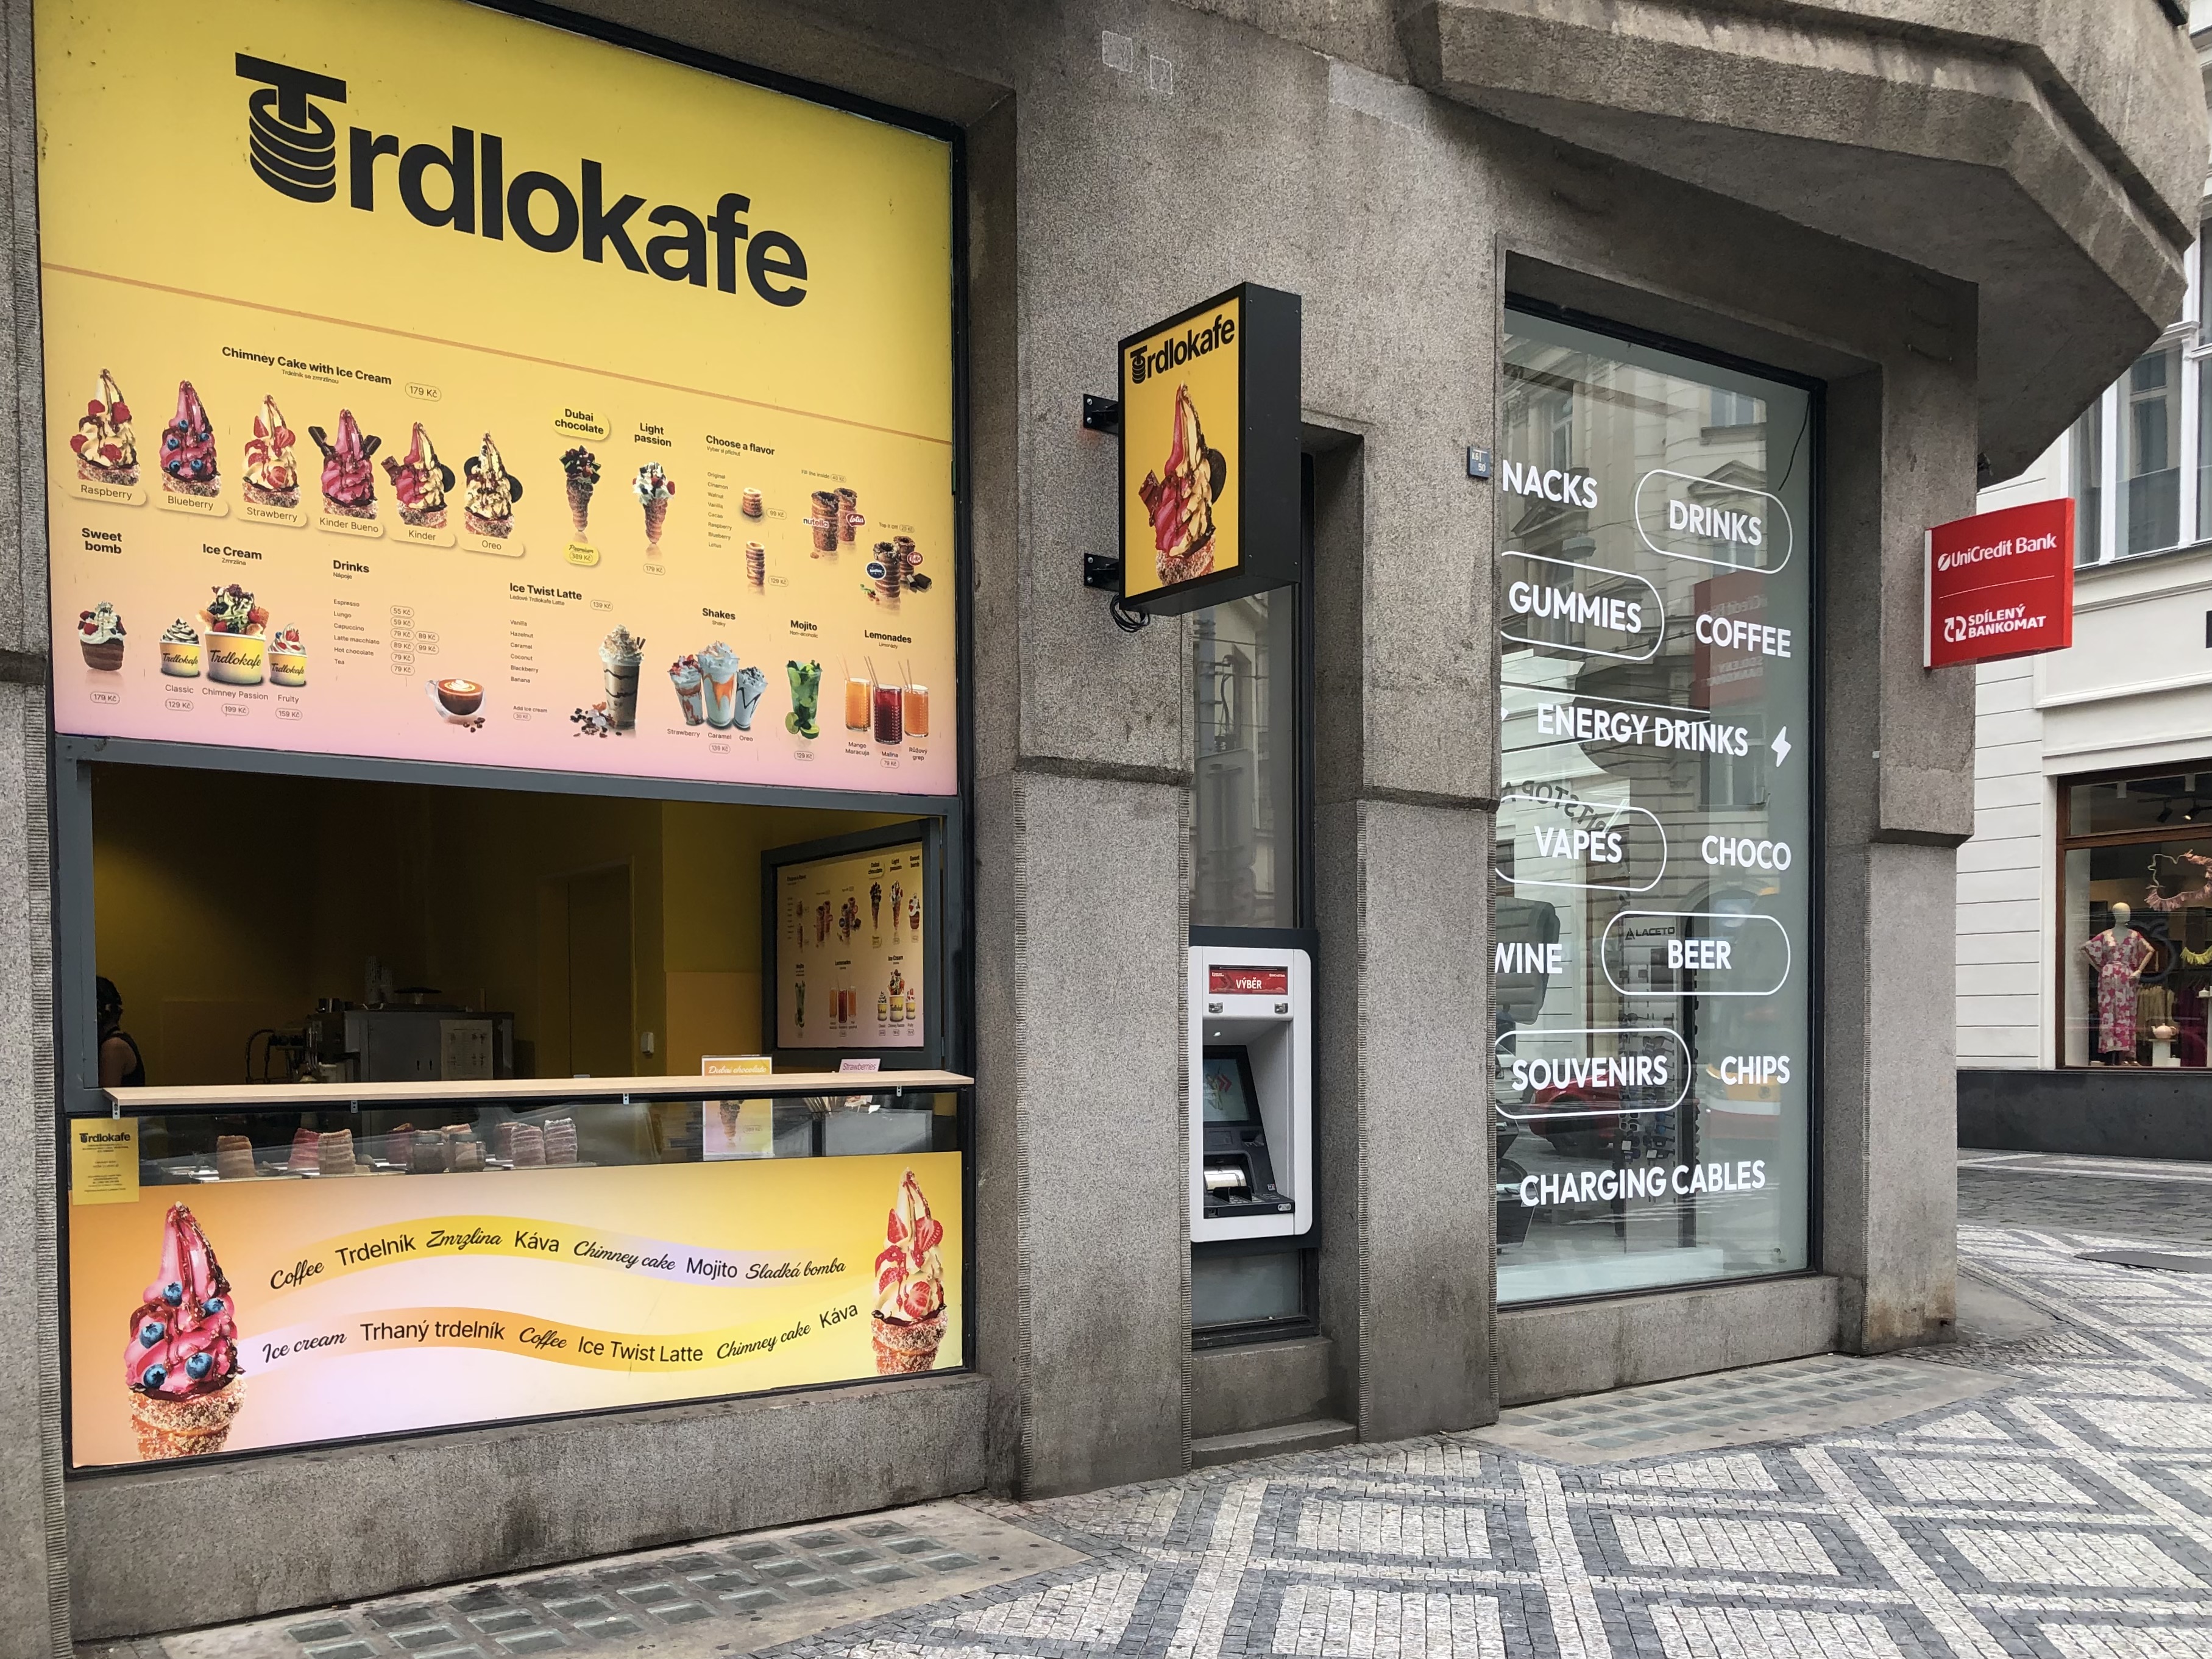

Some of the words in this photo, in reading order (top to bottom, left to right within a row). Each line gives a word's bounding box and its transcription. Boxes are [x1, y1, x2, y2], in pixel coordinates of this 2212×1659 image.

[235, 52, 808, 308] Trdlokafe
[1130, 314, 1235, 385] Trdlokafe
[222, 346, 275, 366] Chimney
[277, 355, 307, 371] Cake
[308, 363, 334, 375] with
[336, 366, 353, 378] Ice
[355, 368, 392, 385] Cream
[409, 385, 424, 396] 179
[426, 387, 438, 399] Kč
[565, 408, 594, 422] Dubai
[555, 419, 604, 435] chocolate
[640, 422, 664, 435] Light
[634, 433, 672, 447] passion
[706, 435, 741, 449] Choose
[750, 442, 775, 455] flavor
[1502, 459, 1598, 509] NACKS
[80, 484, 132, 502] Raspberry
[168, 496, 214, 511] Blueberry
[246, 506, 298, 522] Strawberry
[319, 517, 349, 530] Kinder
[350, 520, 379, 533] Bueno
[708, 522, 732, 531] Raspberry
[803, 519, 829, 528] nutella
[1670, 499, 1762, 546] DRINKS
[82, 527, 122, 542] Sweet
[408, 530, 436, 541] Kinder
[85, 541, 122, 555] bomb
[202, 543, 221, 555] Ice
[222, 546, 262, 560] Cream
[481, 539, 502, 550] Oreo
[1951, 539, 2013, 567] UniCredit
[2016, 532, 2057, 554] Bank
[333, 560, 370, 573] Drinks
[509, 583, 525, 594] Ice
[527, 584, 555, 597] Twist
[556, 588, 583, 600] Latte
[333, 599, 360, 608] Espresso
[1509, 581, 1642, 634] GUMMIES
[333, 611, 352, 619] Lungo
[702, 608, 736, 621] Shakes
[1968, 603, 2026, 627] SDÍLENÝ
[333, 623, 364, 631] Capuccino
[790, 619, 818, 631] Mojito
[1968, 616, 2047, 639] BANKOMAT
[350, 636, 380, 645] macchiato
[864, 630, 912, 644] Lemonades
[1695, 614, 1791, 658] COFFEE
[346, 647, 374, 656] chocolate
[210, 650, 261, 668] Trdlokafe
[511, 665, 539, 673] Blackberry
[165, 684, 194, 694] Classic
[202, 687, 236, 698] Chimney
[238, 691, 269, 700] Passion
[182, 701, 191, 709] Kč
[277, 694, 300, 704] Fruity
[667, 728, 700, 739] Strawberry
[707, 732, 732, 741] Caramel
[1537, 702, 1650, 745] ENERGY
[1654, 718, 1749, 757] DRINKS
[845, 748, 870, 758] Maracuja
[848, 741, 867, 751] Mango
[1533, 825, 1623, 864] VAPES
[1701, 835, 1792, 871] CHOCO
[1636, 926, 1676, 937] LACETO
[1495, 942, 1563, 975] WINE
[1668, 939, 1732, 970] BEER
[1235, 976, 1262, 989] VÝBĚR
[708, 1065, 732, 1075] Dubai
[733, 1065, 767, 1074] chocolate
[842, 1062, 877, 1073] Strawberries
[1511, 1055, 1668, 1092] SOUVENIRS
[1720, 1055, 1790, 1085] CHIPS
[79, 1132, 131, 1143] Trdlokafe
[1520, 1167, 1667, 1207] CHARGING
[1671, 1160, 1766, 1196] CABLES
[271, 1259, 325, 1290] Coffee
[335, 1234, 417, 1266] Trdelník
[426, 1227, 503, 1250] Zmrzlina
[514, 1230, 560, 1253] Káva
[573, 1240, 640, 1270] Chimney
[641, 1253, 676, 1271] cake
[686, 1257, 739, 1281] Mojito
[745, 1262, 801, 1280] Sladká
[803, 1257, 846, 1277] bomba
[262, 1343, 291, 1363] Ice
[293, 1330, 347, 1351] cream
[360, 1320, 430, 1343] Trhaný
[434, 1320, 506, 1340] trdelník
[519, 1327, 567, 1350] Coffee
[578, 1336, 605, 1356] Ice
[611, 1341, 656, 1362] Twist
[659, 1345, 704, 1363] Latte
[717, 1335, 778, 1360] Chimney
[780, 1321, 812, 1343] cake
[819, 1303, 859, 1329] Káva
